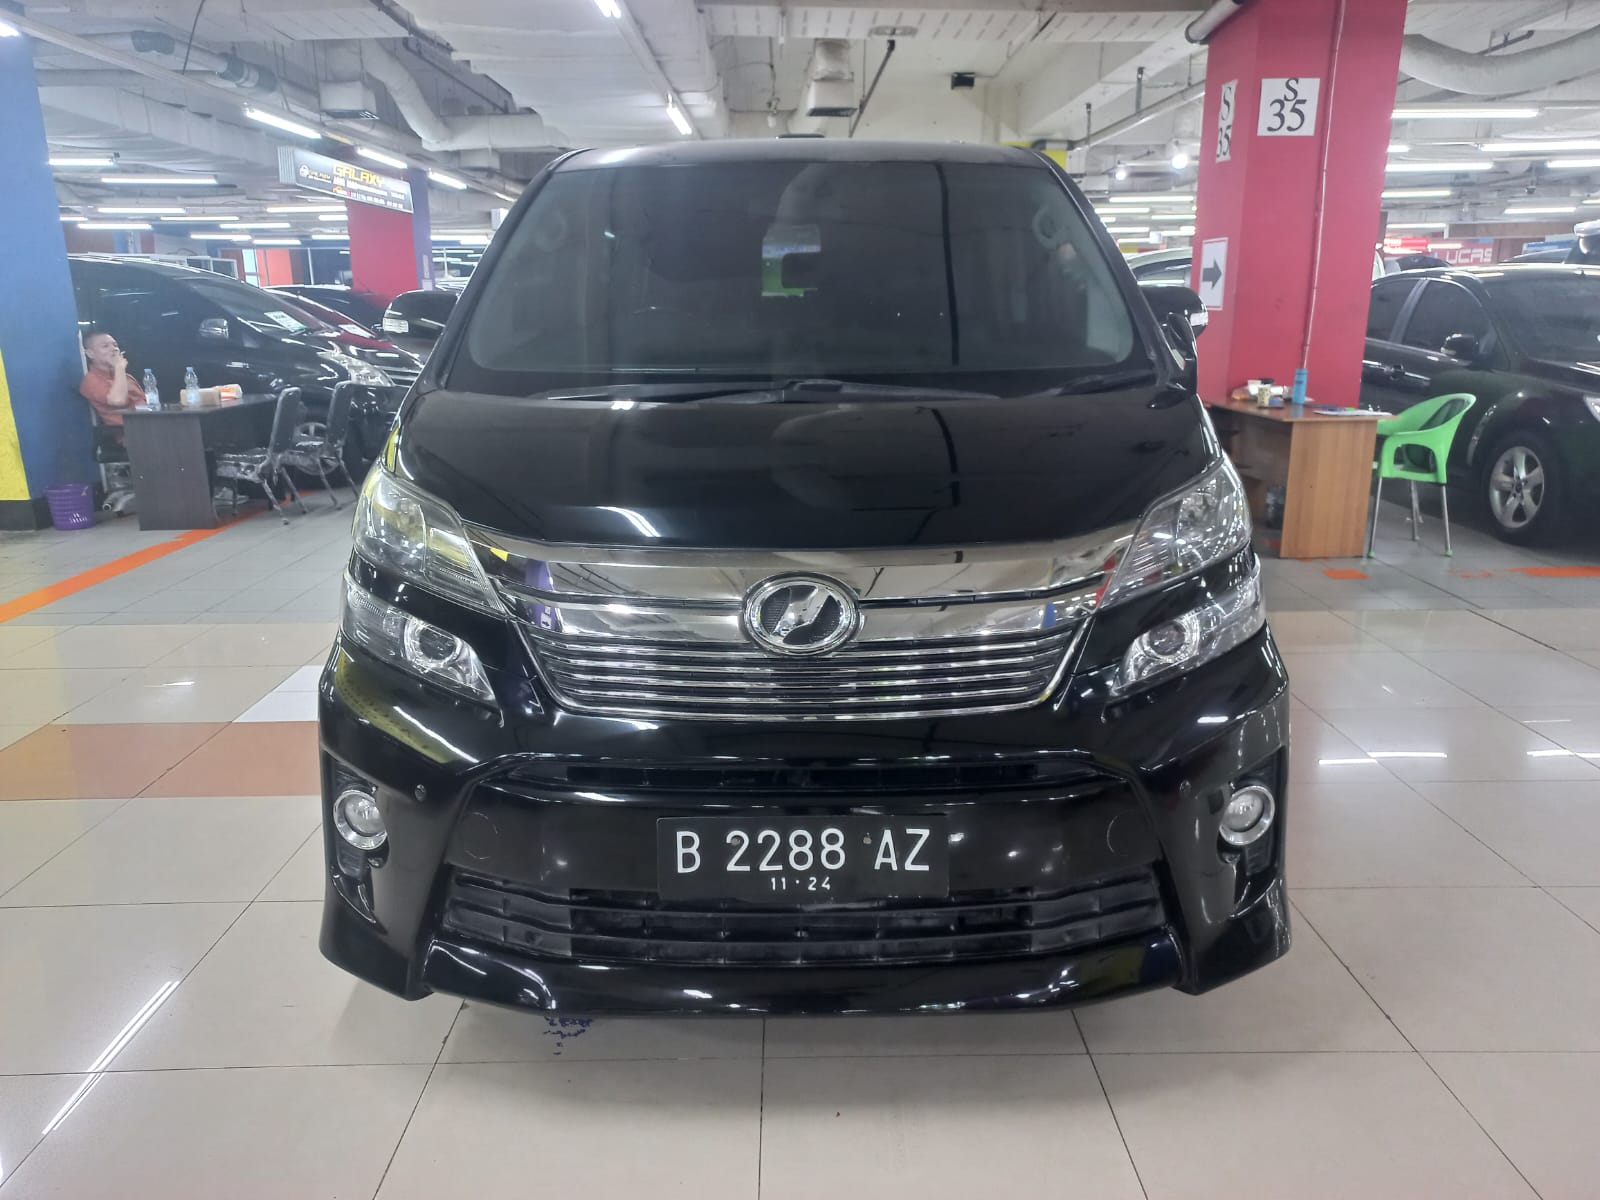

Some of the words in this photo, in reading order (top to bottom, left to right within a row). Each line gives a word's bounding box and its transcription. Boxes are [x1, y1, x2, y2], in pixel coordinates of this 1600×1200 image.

[1221, 86, 1232, 121] S
[1284, 77, 1299, 102] S
[1267, 98, 1307, 132] 35
[1216, 124, 1232, 156] 35
[333, 164, 385, 187] GALAXY
[676, 830, 701, 873] B
[725, 827, 846, 872] 2288
[874, 828, 931, 872] AZ
